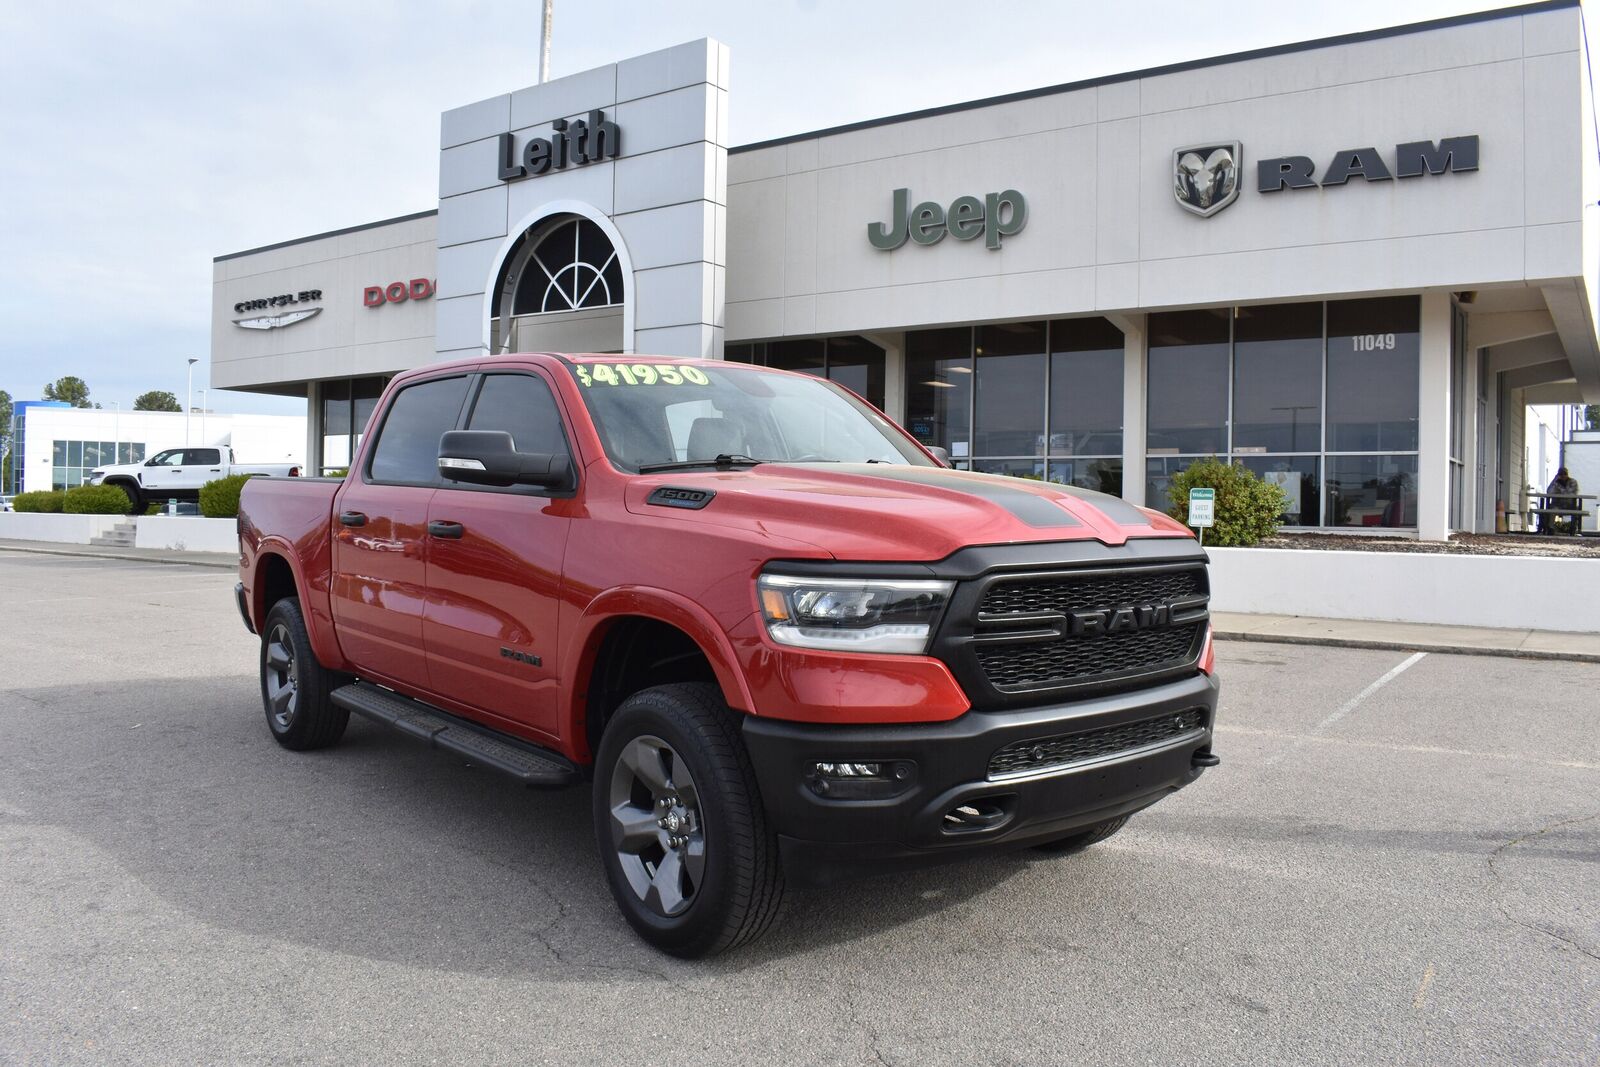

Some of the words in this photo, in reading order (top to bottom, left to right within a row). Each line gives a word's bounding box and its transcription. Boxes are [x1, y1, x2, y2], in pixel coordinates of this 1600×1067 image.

[498, 108, 620, 181] Leith
[1257, 134, 1479, 193] RAM
[867, 188, 1029, 251] Jeep
[234, 289, 322, 313] CHRYSLER
[363, 278, 437, 308] DOD
[1352, 333, 1396, 352] 11049
[576, 363, 709, 387] $41950
[659, 489, 706, 501] 1500
[1070, 605, 1168, 636] RAM
